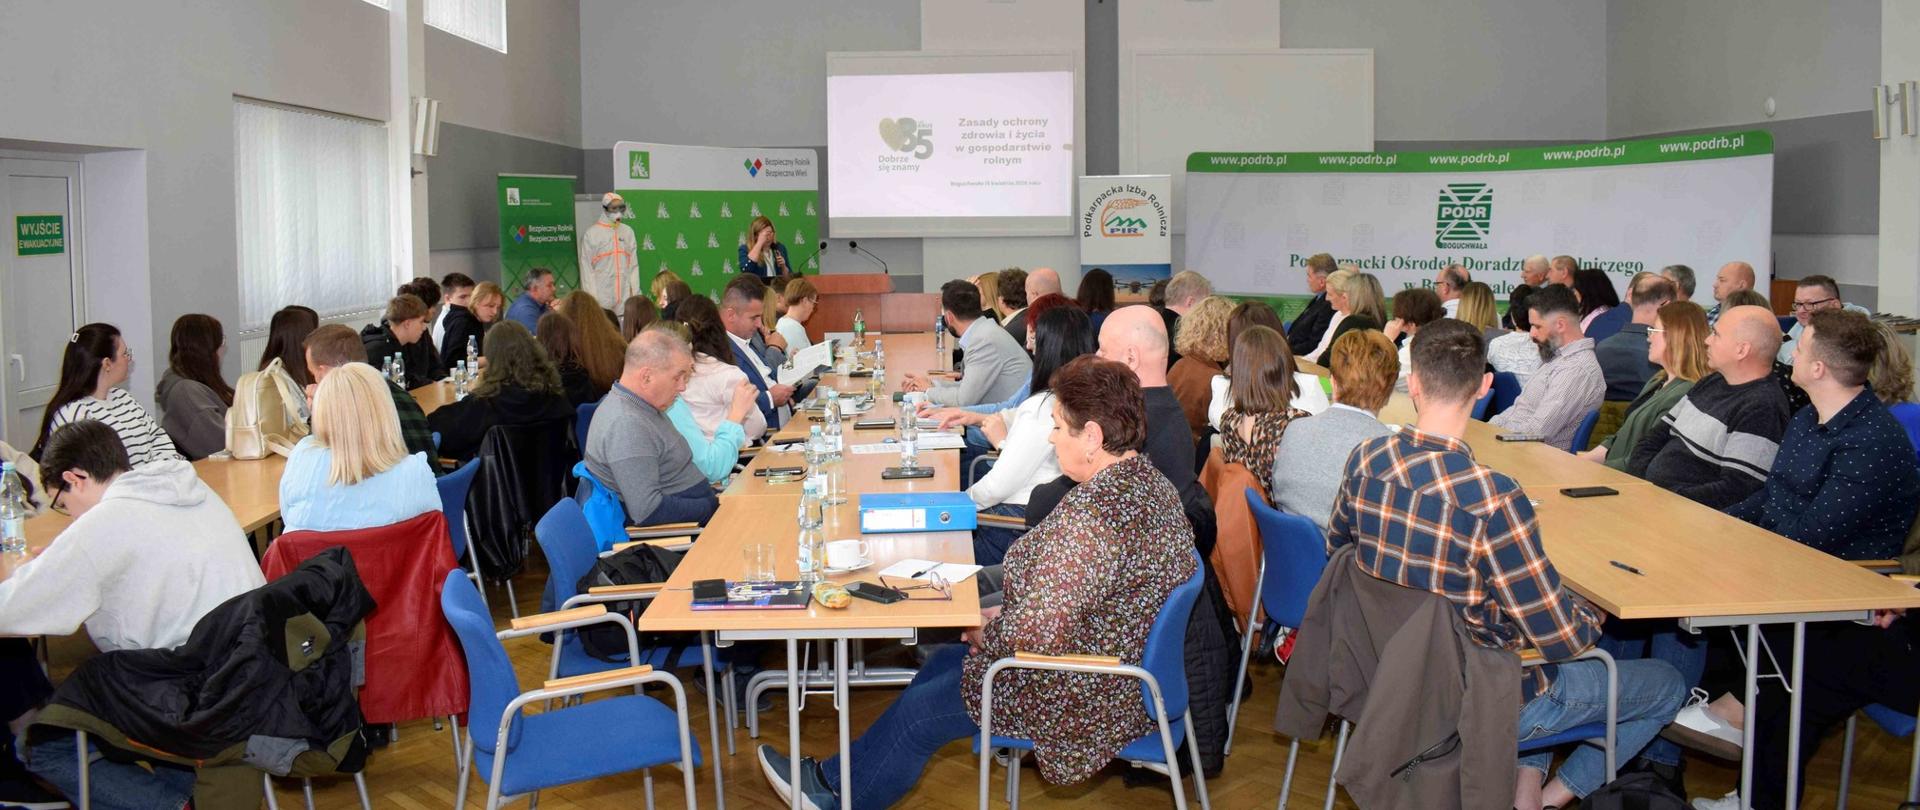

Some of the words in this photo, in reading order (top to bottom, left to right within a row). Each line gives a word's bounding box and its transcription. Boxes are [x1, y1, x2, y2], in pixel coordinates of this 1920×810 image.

[958, 118, 999, 128] Zasady
[1002, 117, 1048, 127] ochrony
[961, 131, 1005, 139] zdrowia
[1015, 130, 1045, 140] życia
[968, 143, 1052, 153] gospodarstwie
[1659, 135, 1745, 153] www.podrb.pl
[1429, 152, 1510, 165] www.podrb.pl
[1543, 145, 1626, 160] www.podrb.pl
[879, 155, 909, 163] Dobrze
[983, 156, 1022, 166] rolnym
[1210, 154, 1287, 166] www.podrb.pl
[1319, 153, 1397, 166] www.podrb.pl
[1084, 186, 1123, 238] Podkarpacka
[1126, 184, 1147, 197] Izba
[1147, 194, 1167, 237] Rolnicza
[1441, 206, 1487, 218] PODR
[21, 220, 61, 235] WYJŚCIE
[18, 239, 64, 248] EWAKUACYJNE
[1290, 254, 1386, 270] Poracki
[1391, 255, 1456, 270] Ośrodek
[1578, 257, 1643, 277] lniczego
